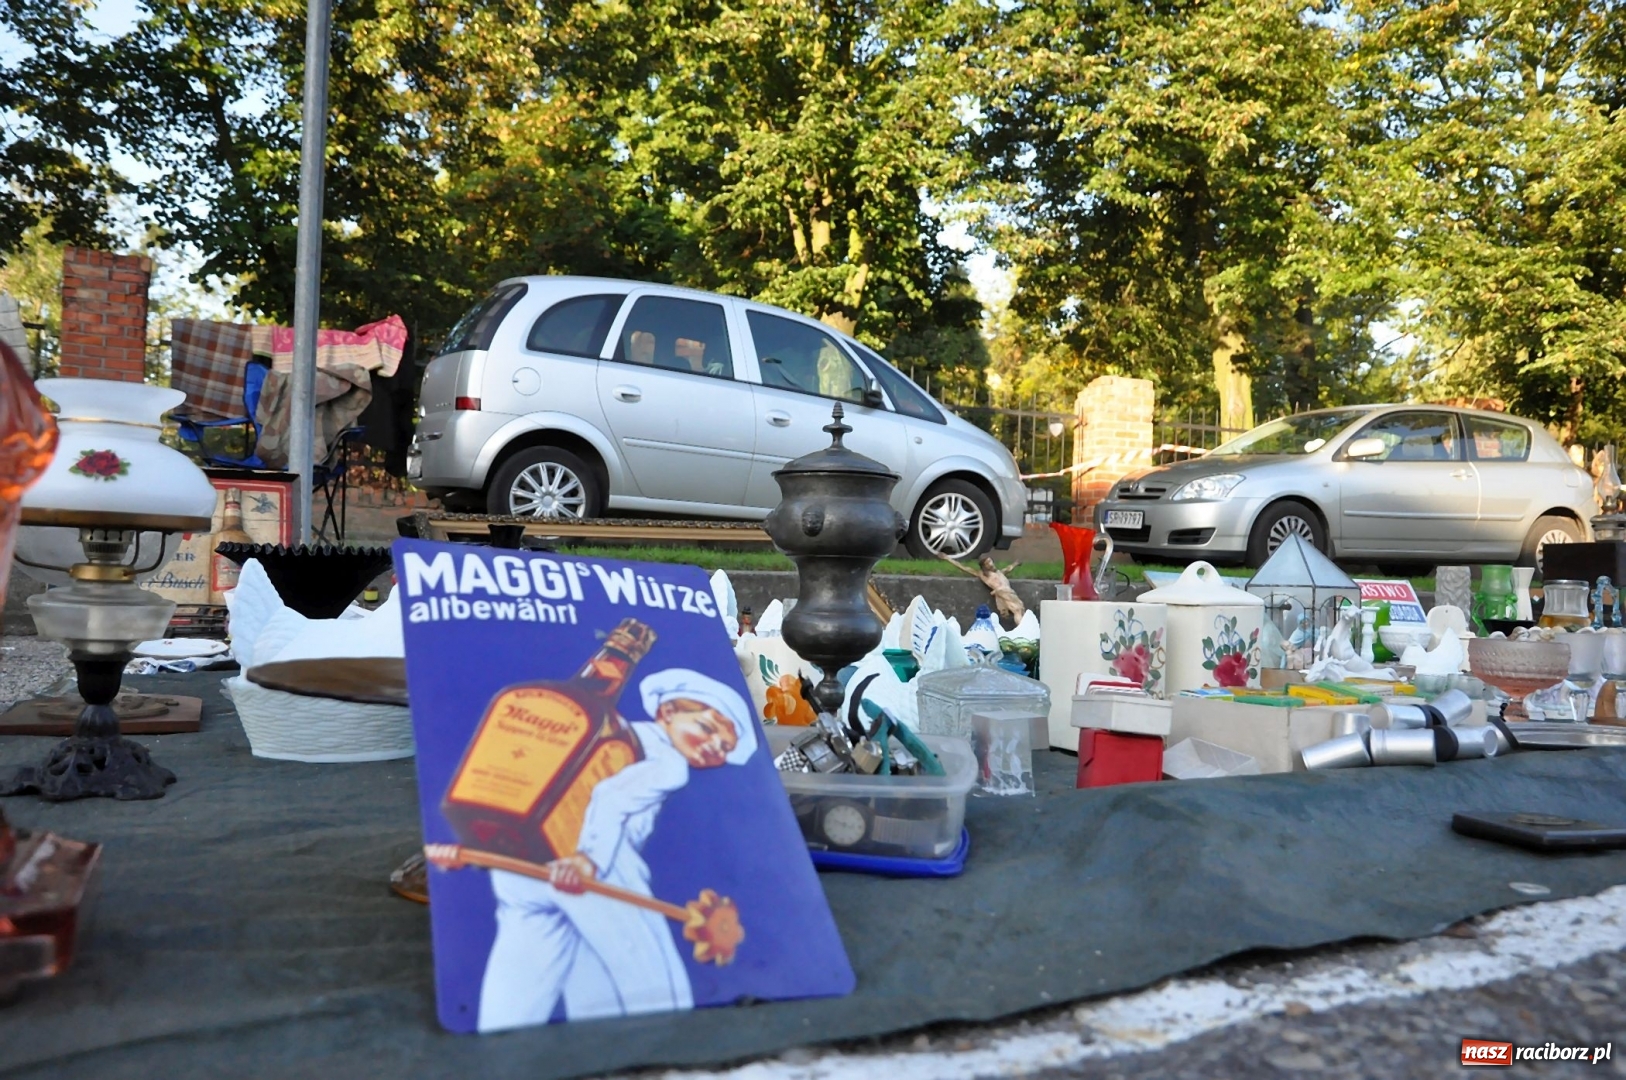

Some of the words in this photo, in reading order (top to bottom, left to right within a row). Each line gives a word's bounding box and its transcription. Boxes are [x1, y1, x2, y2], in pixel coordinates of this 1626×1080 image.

[172, 552, 196, 562] ER
[592, 565, 717, 618] Würze
[409, 595, 578, 625] altbewährt
